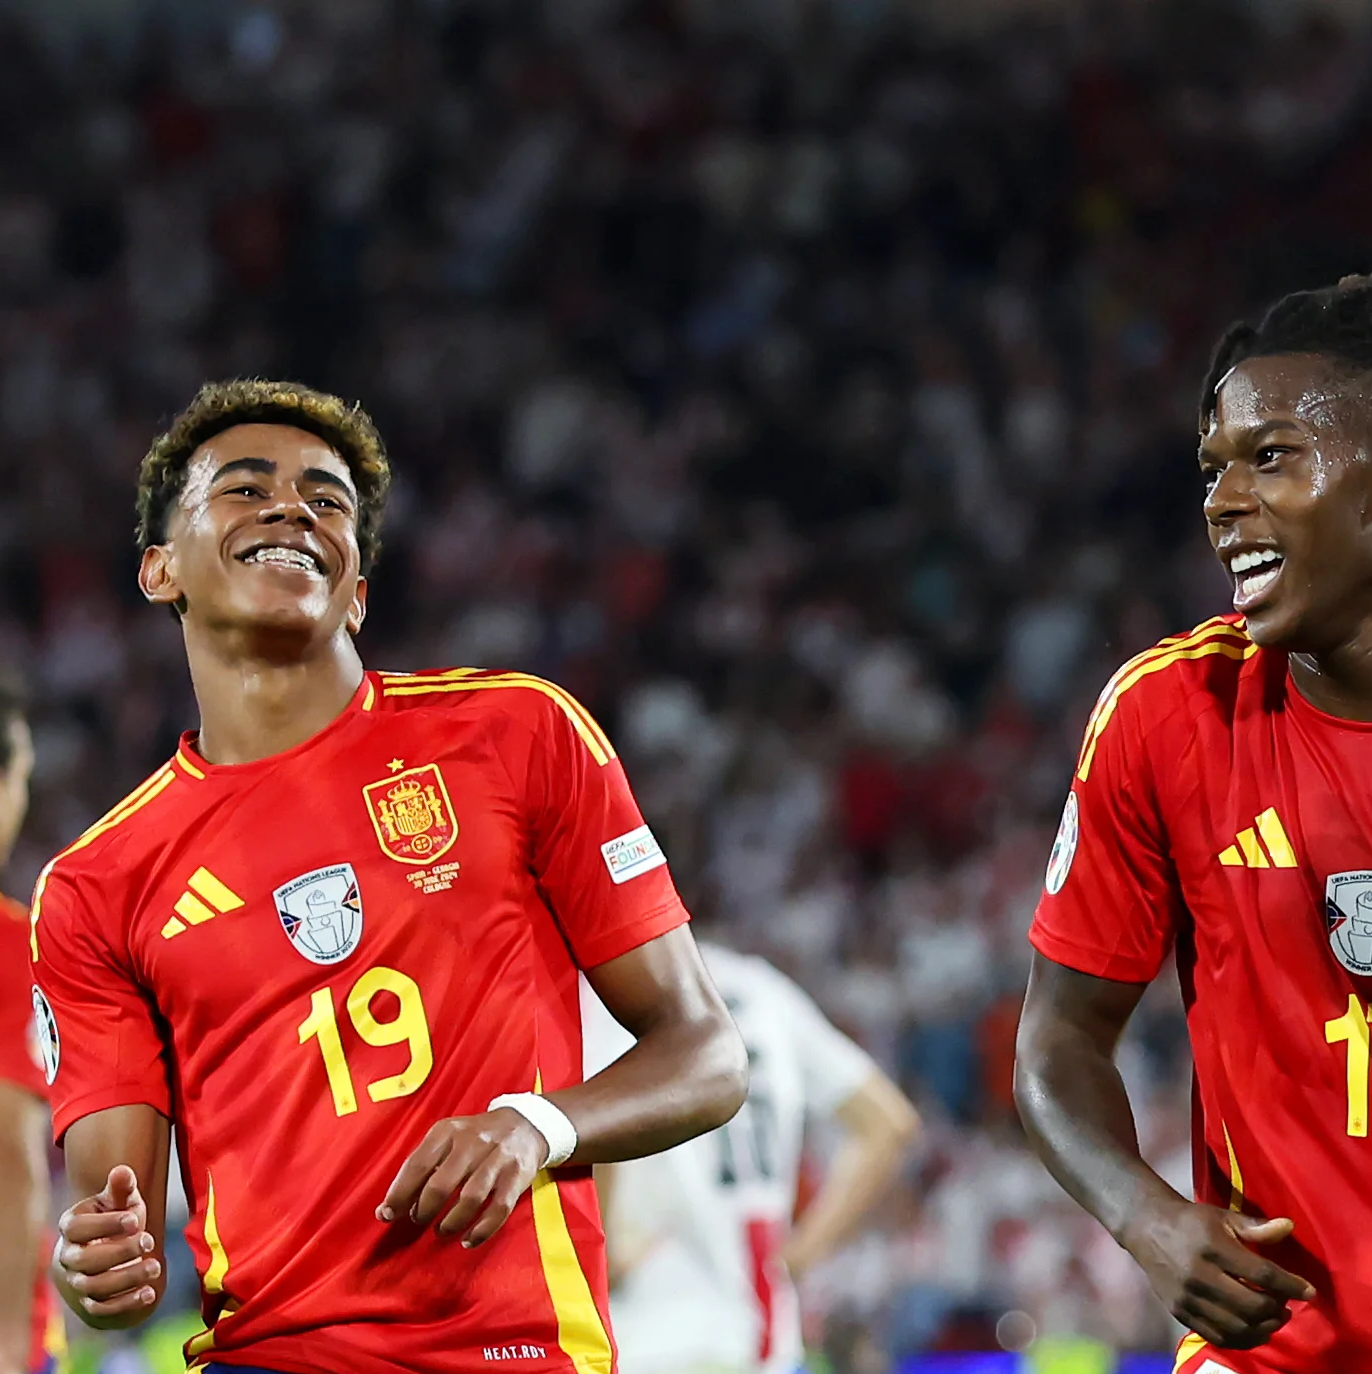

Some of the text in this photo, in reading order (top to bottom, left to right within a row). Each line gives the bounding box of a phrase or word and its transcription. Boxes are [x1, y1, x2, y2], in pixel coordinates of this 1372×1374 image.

[605, 840, 626, 855] UEFA
[1331, 875, 1349, 885] UEFA
[1345, 958, 1372, 972] WINNER
[297, 965, 434, 1118] 19
[483, 1344, 547, 1361] HEAT.RDY
